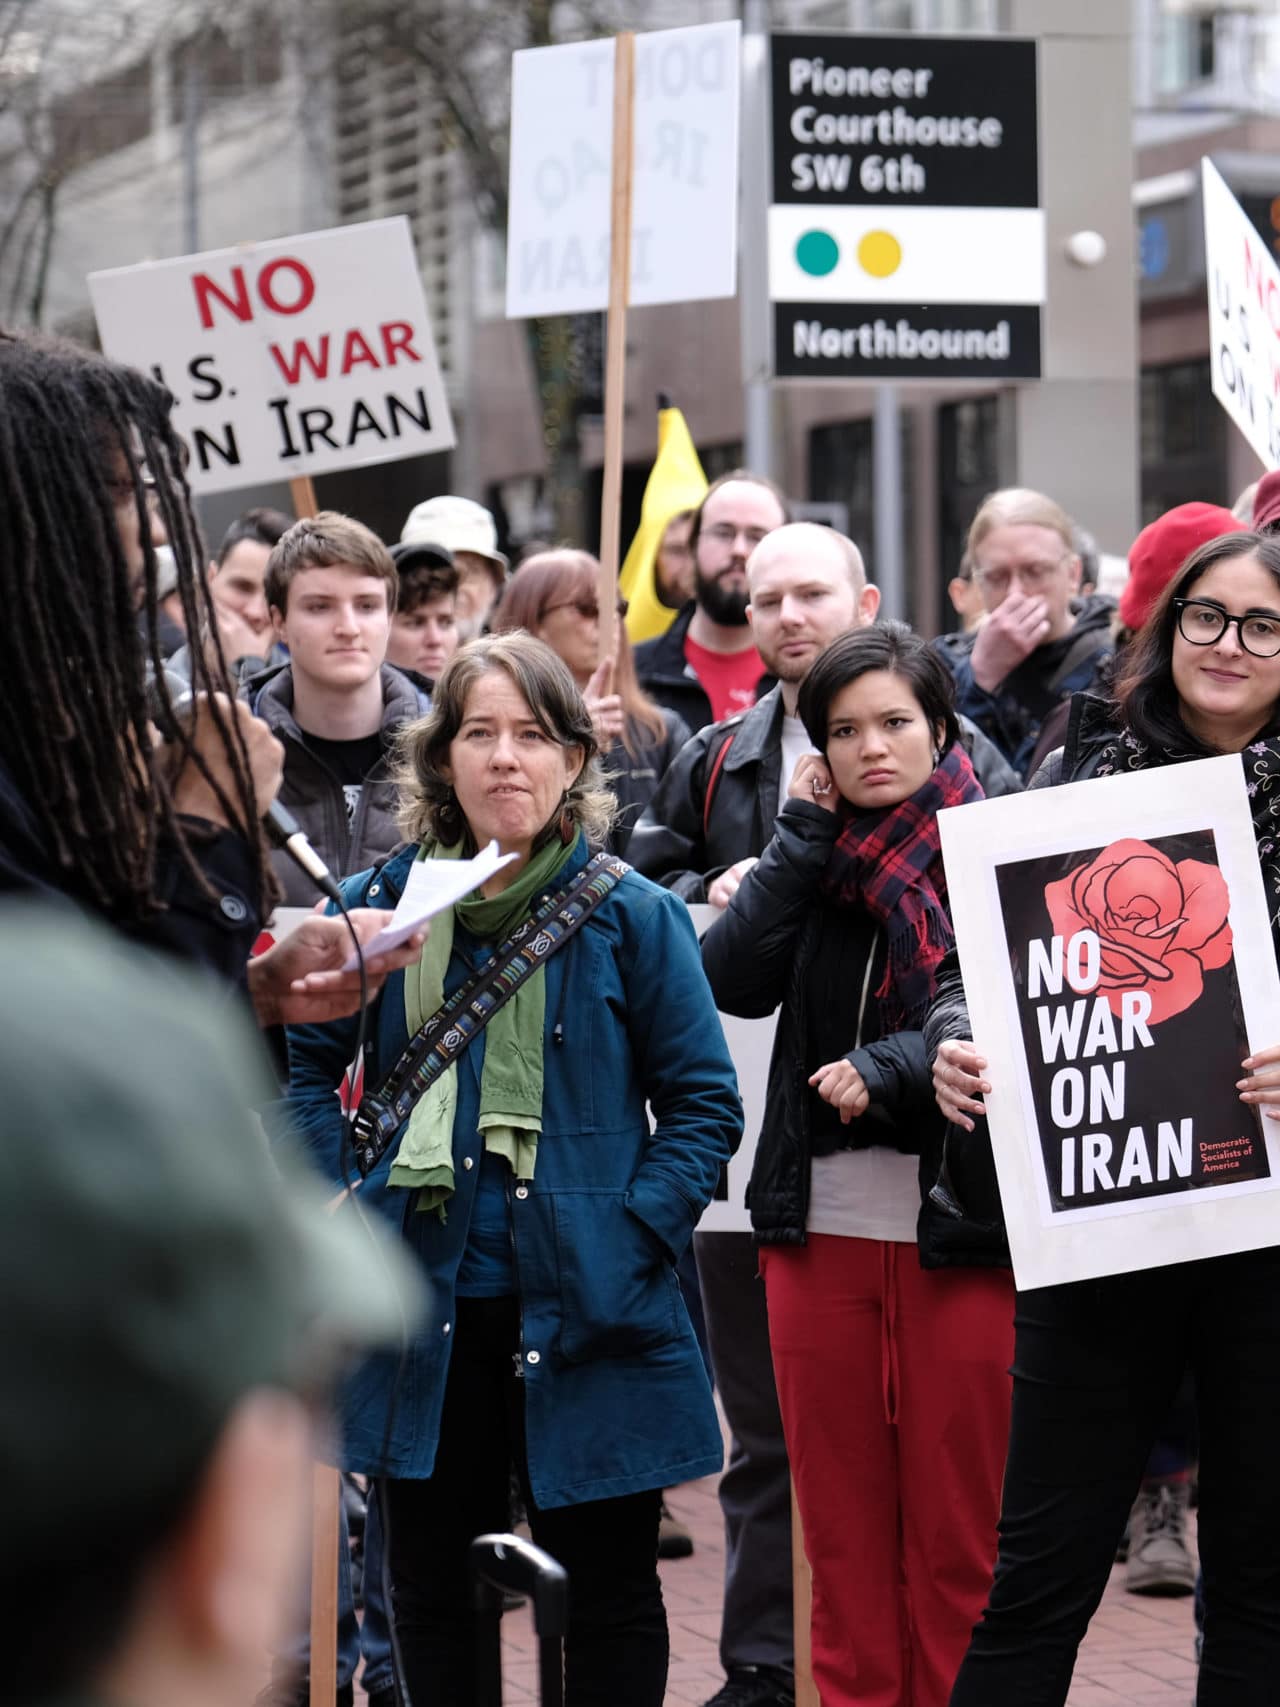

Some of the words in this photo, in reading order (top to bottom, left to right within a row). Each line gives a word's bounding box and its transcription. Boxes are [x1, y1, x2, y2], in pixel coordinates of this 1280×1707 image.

[789, 57, 932, 98] Pioneer
[790, 105, 1003, 147] Courthouse
[791, 153, 851, 191] SW
[860, 153, 925, 193] 6th
[191, 256, 315, 329] NO
[154, 356, 237, 405] .S.
[268, 320, 423, 386] WAR
[793, 319, 1010, 358] Northbound
[1220, 343, 1255, 425] ON
[192, 423, 241, 471] N
[268, 387, 433, 458] IRAN
[1028, 929, 1101, 999] NO
[1037, 990, 1155, 1064] WAR
[1051, 1061, 1125, 1129] ON
[1061, 1117, 1193, 1197] IRAN
[1200, 1136, 1250, 1151] Democratic
[1201, 1149, 1241, 1162] Socialists
[1243, 1146, 1253, 1155] of
[1203, 1160, 1240, 1173] America
